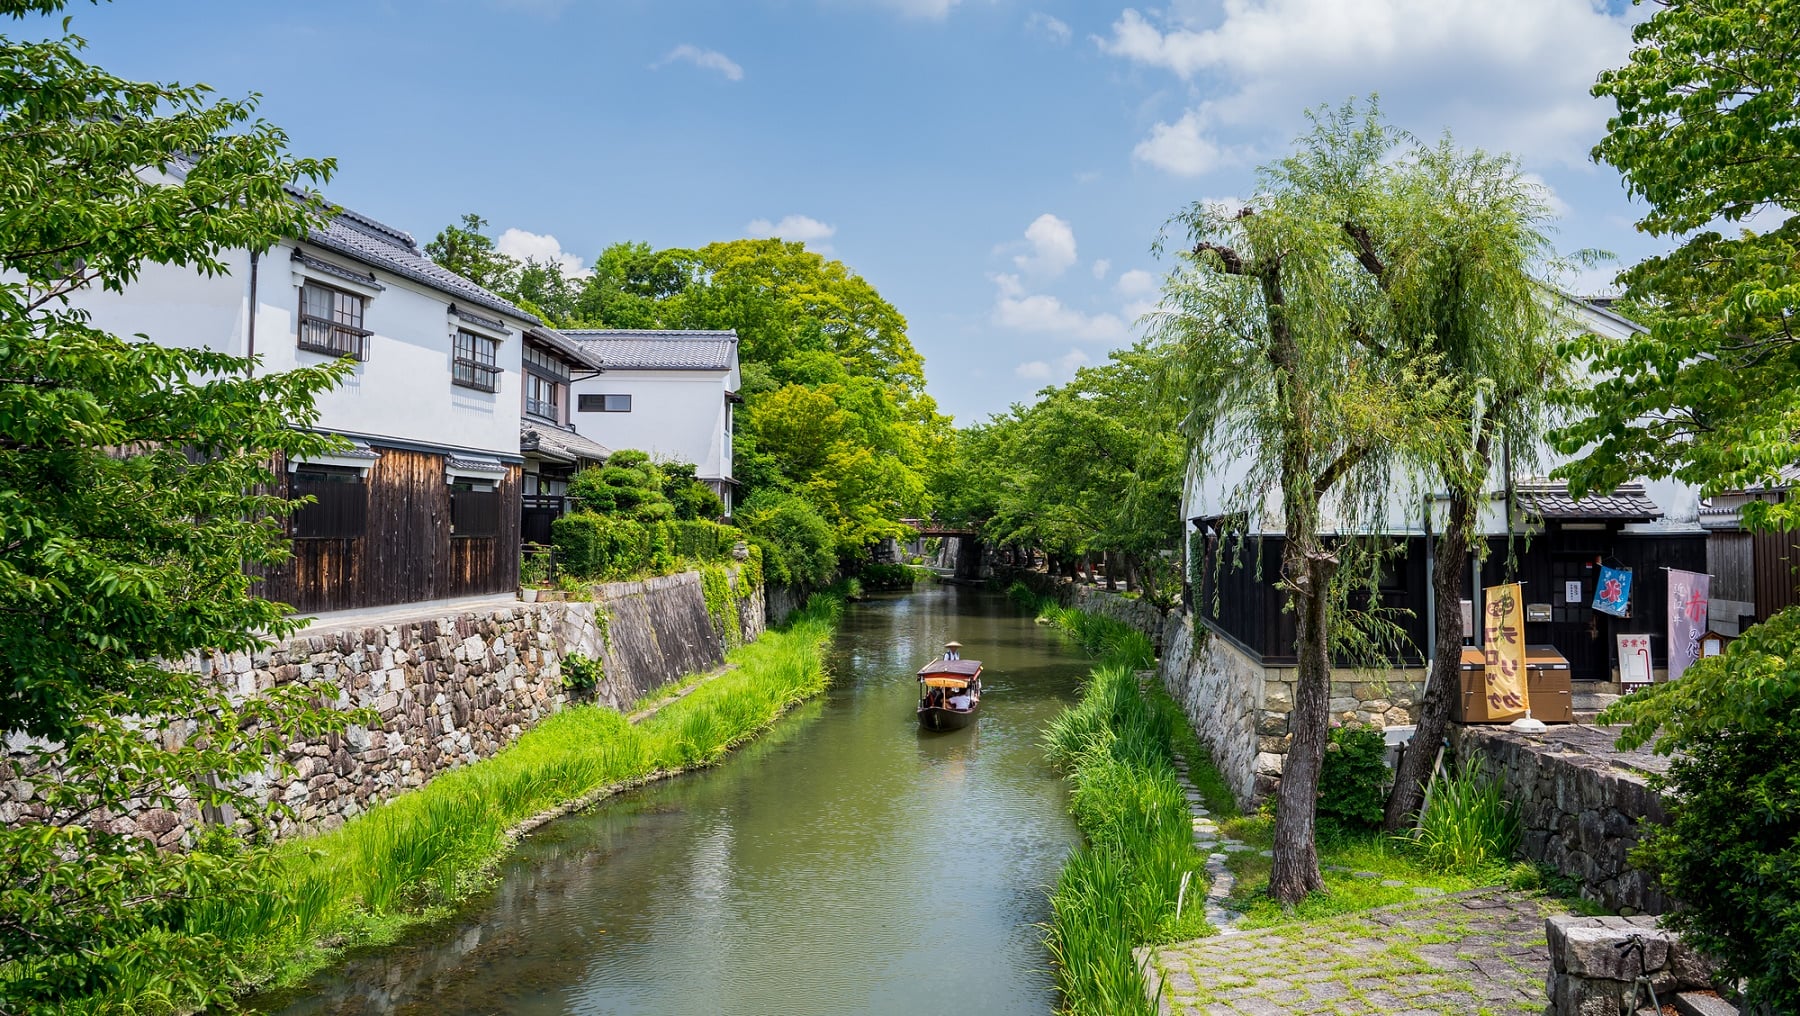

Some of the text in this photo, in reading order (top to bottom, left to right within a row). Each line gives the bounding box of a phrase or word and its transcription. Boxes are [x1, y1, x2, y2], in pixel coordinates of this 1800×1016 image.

[1673, 583, 1686, 627] 近江牛
[1621, 639, 1647, 648] 営業中
